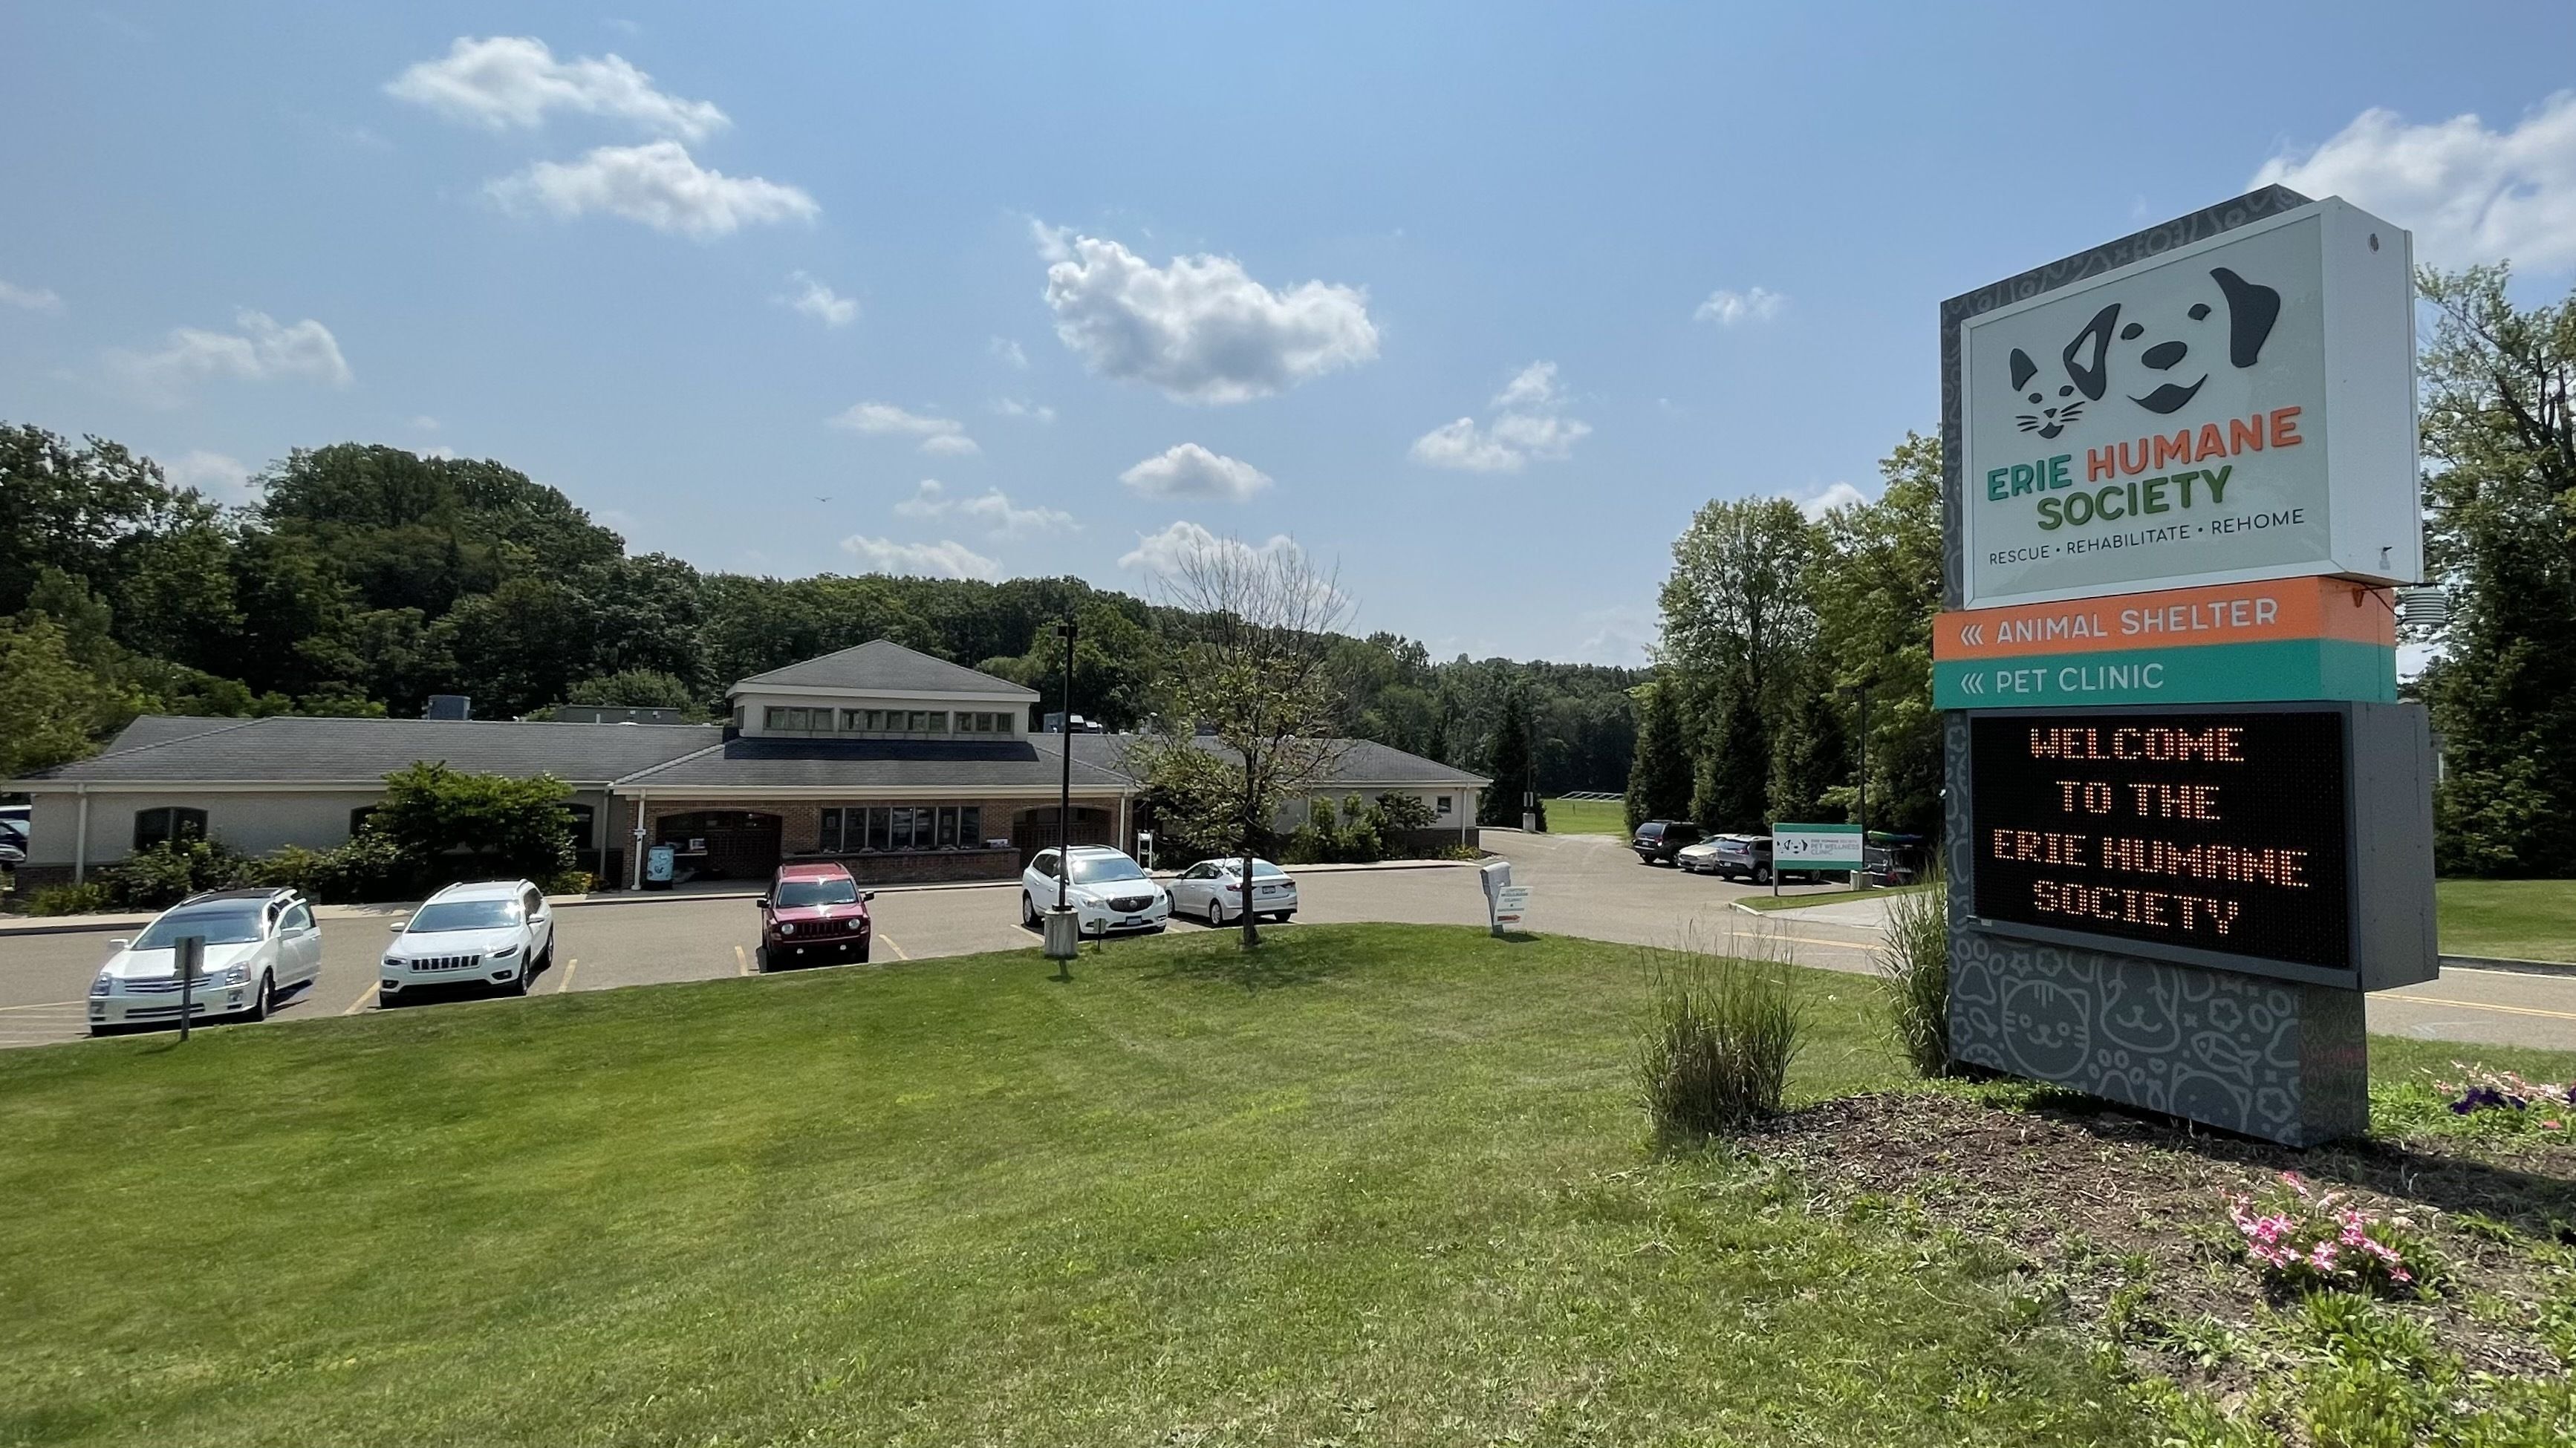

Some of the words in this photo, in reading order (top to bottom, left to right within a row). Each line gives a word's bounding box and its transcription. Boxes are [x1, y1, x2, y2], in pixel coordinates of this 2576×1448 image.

[1987, 454, 2073, 502] ERIE
[2088, 407, 2302, 481] HUMANE
[2037, 464, 2233, 530] SOCIETY
[1989, 544, 2050, 565] RESCUE
[2066, 524, 2190, 555] REHABILITATE
[2211, 508, 2305, 535] REHOME
[1997, 613, 2108, 644] ANIMAL
[2121, 598, 2279, 635] SHELTER
[1996, 669, 2048, 694] PET
[2058, 662, 2164, 691] CLINIC
[2031, 727, 2245, 762] WELCOME
[2056, 780, 2112, 814] TO
[2129, 783, 2221, 821] THE
[1994, 829, 2087, 867] ERIE
[2103, 836, 2309, 888] HUMANE
[2033, 880, 2239, 936] SOCIETY
